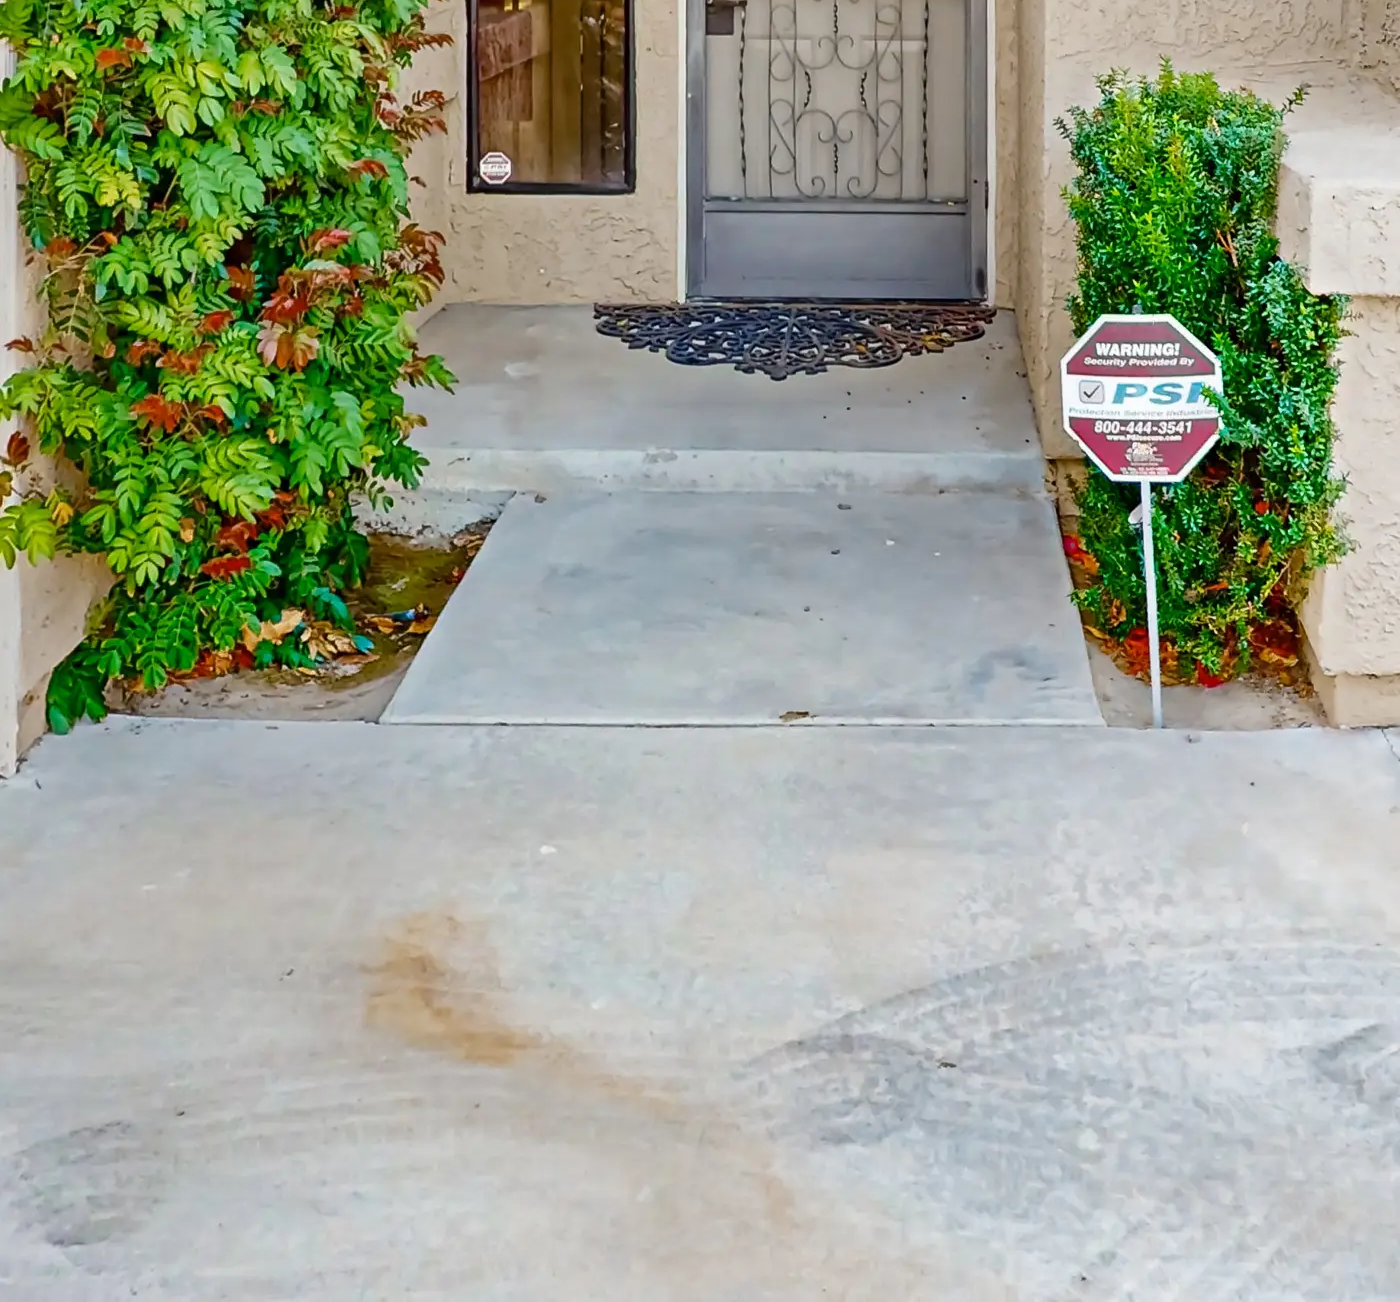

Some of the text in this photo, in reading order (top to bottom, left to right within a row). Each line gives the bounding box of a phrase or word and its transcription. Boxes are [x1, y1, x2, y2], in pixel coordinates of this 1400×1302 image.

[1095, 342, 1180, 356] WARNING!
[1084, 357, 1195, 367] Security Provided By
[1111, 382, 1205, 404] PSI
[1069, 407, 1120, 416] Protection
[1123, 409, 1164, 417] Service
[1094, 420, 1192, 434] 800-444-3541
